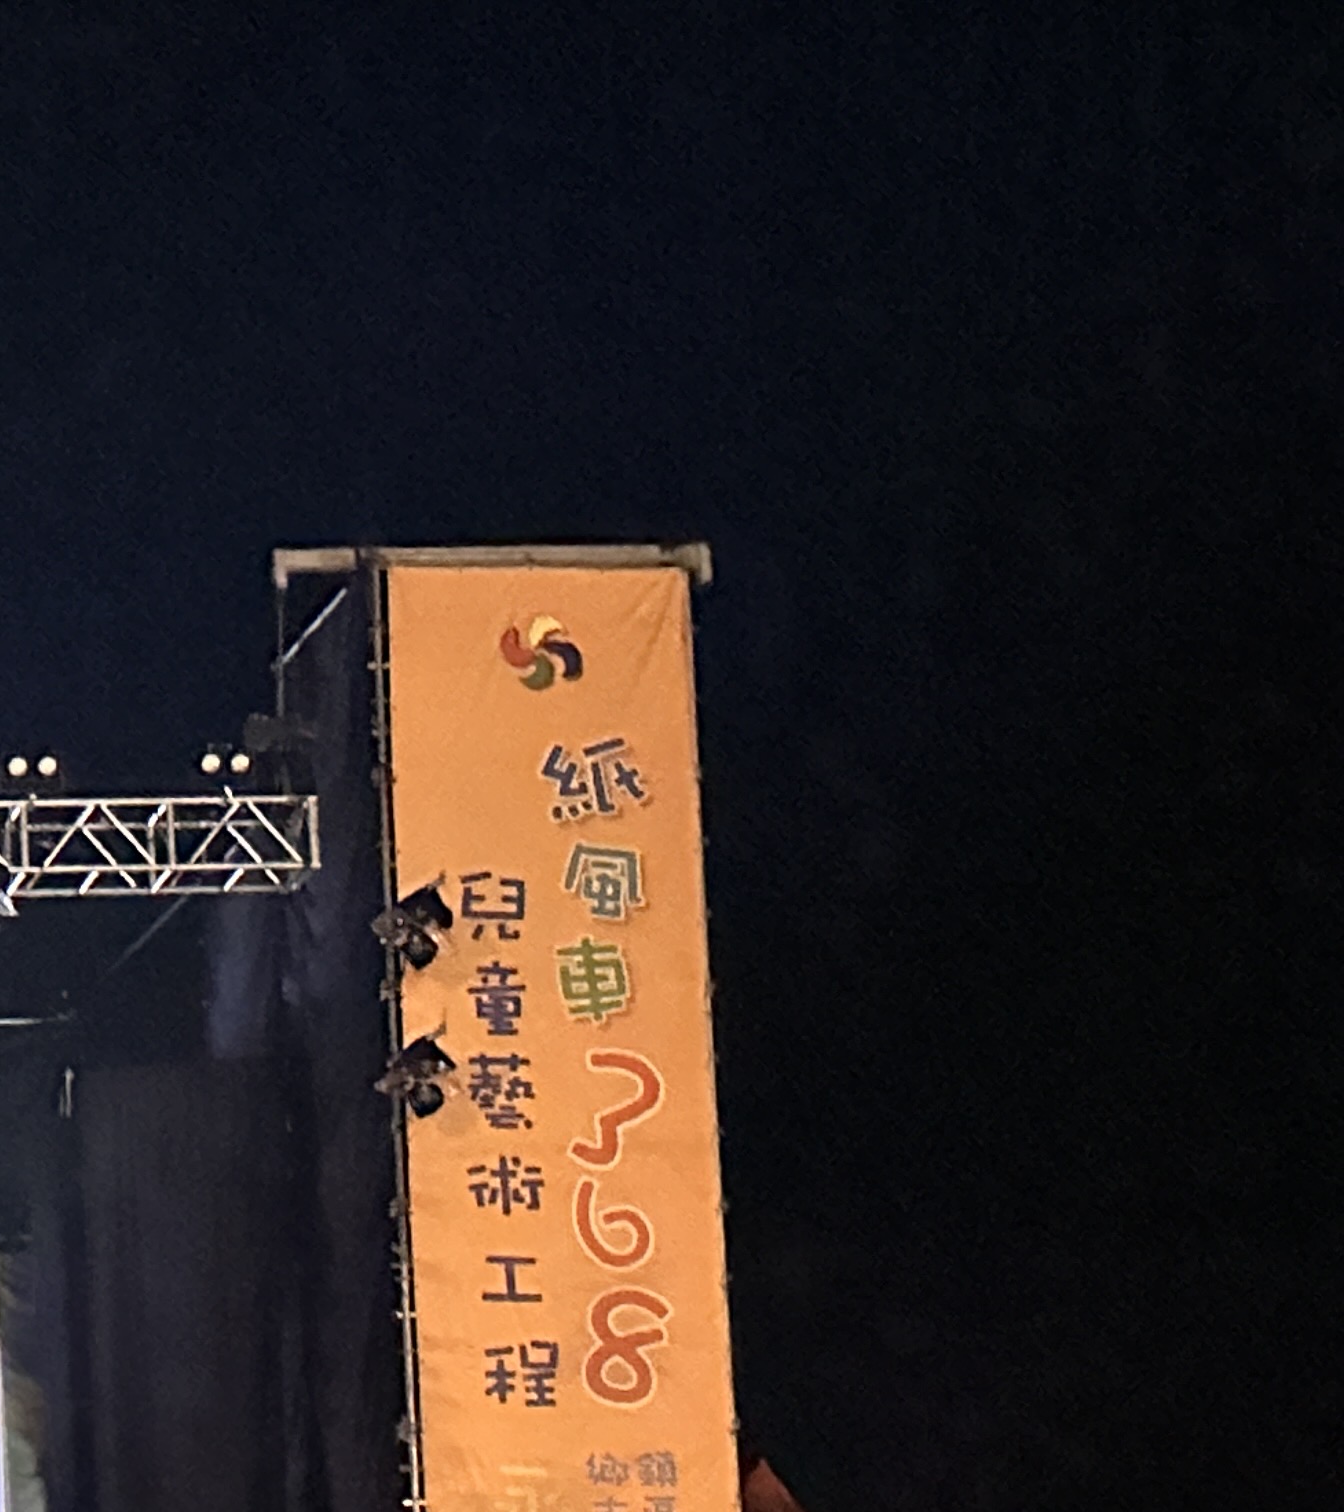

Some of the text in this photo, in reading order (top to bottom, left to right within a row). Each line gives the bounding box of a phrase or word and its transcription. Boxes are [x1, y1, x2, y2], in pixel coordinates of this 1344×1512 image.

[460, 871, 559, 1408] 兒童藝術工程
